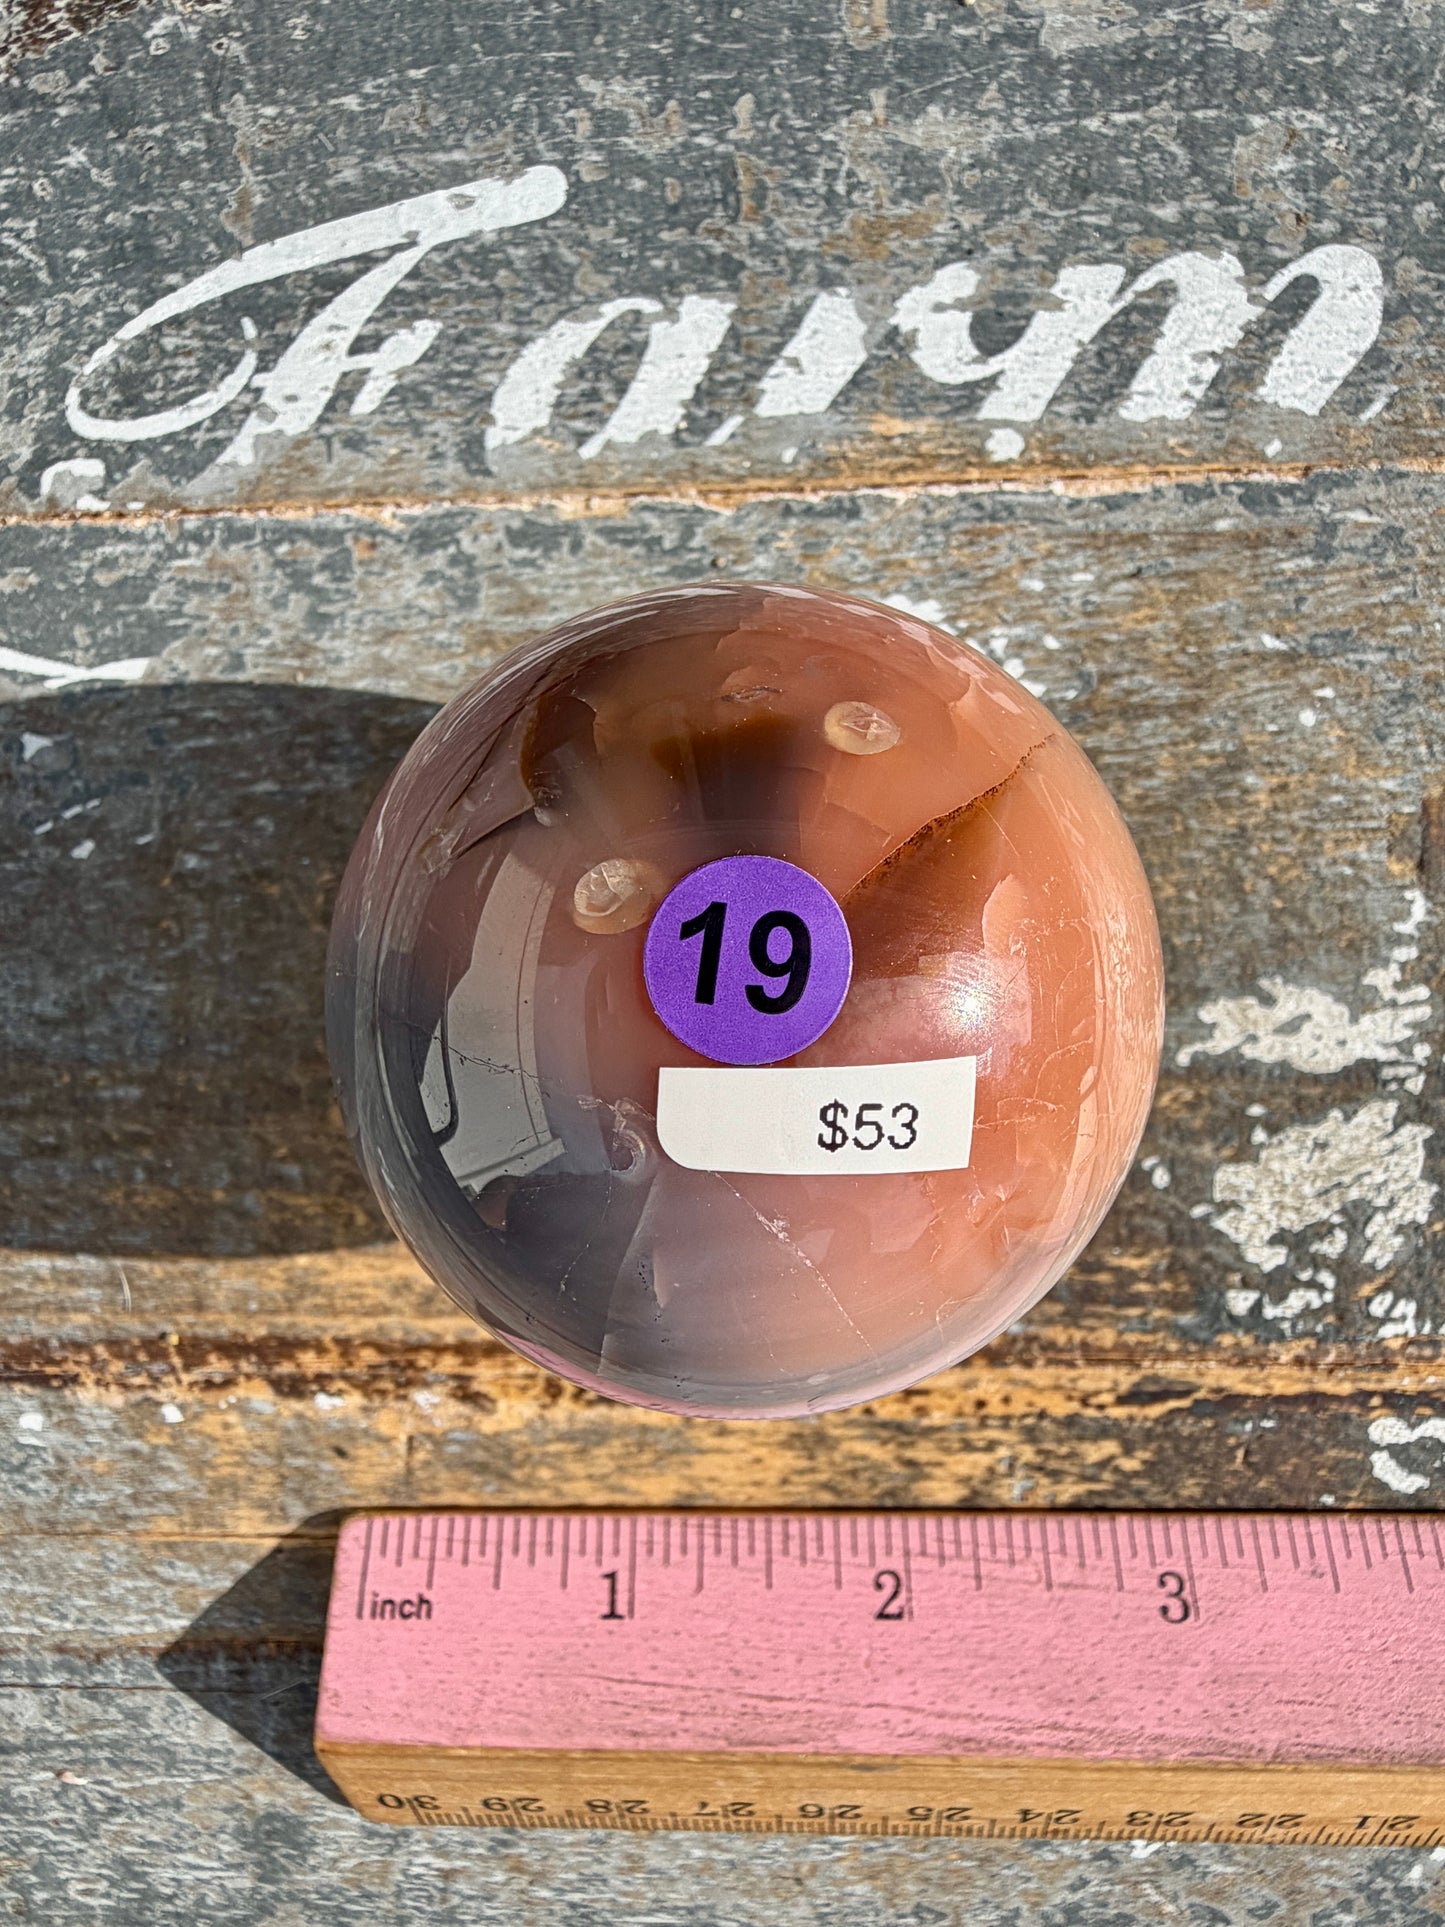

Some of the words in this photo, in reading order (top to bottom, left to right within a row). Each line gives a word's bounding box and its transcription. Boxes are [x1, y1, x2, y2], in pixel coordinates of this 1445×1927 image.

[679, 901, 812, 1015] 19
[817, 1098, 919, 1153] $53
[369, 1592, 433, 1620] inch
[601, 1571, 625, 1620] 1
[873, 1570, 905, 1621] 2
[1157, 1572, 1191, 1624] 3
[376, 1792, 438, 1811] 30
[482, 1796, 544, 1813] 29
[584, 1798, 651, 1816] 28
[695, 1800, 756, 1818] 27
[799, 1802, 864, 1820] 26
[906, 1805, 973, 1823] 25
[1017, 1807, 1084, 1826] 24
[1126, 1809, 1197, 1829] 23
[1235, 1812, 1307, 1830] 22
[1350, 1813, 1421, 1832] 21
